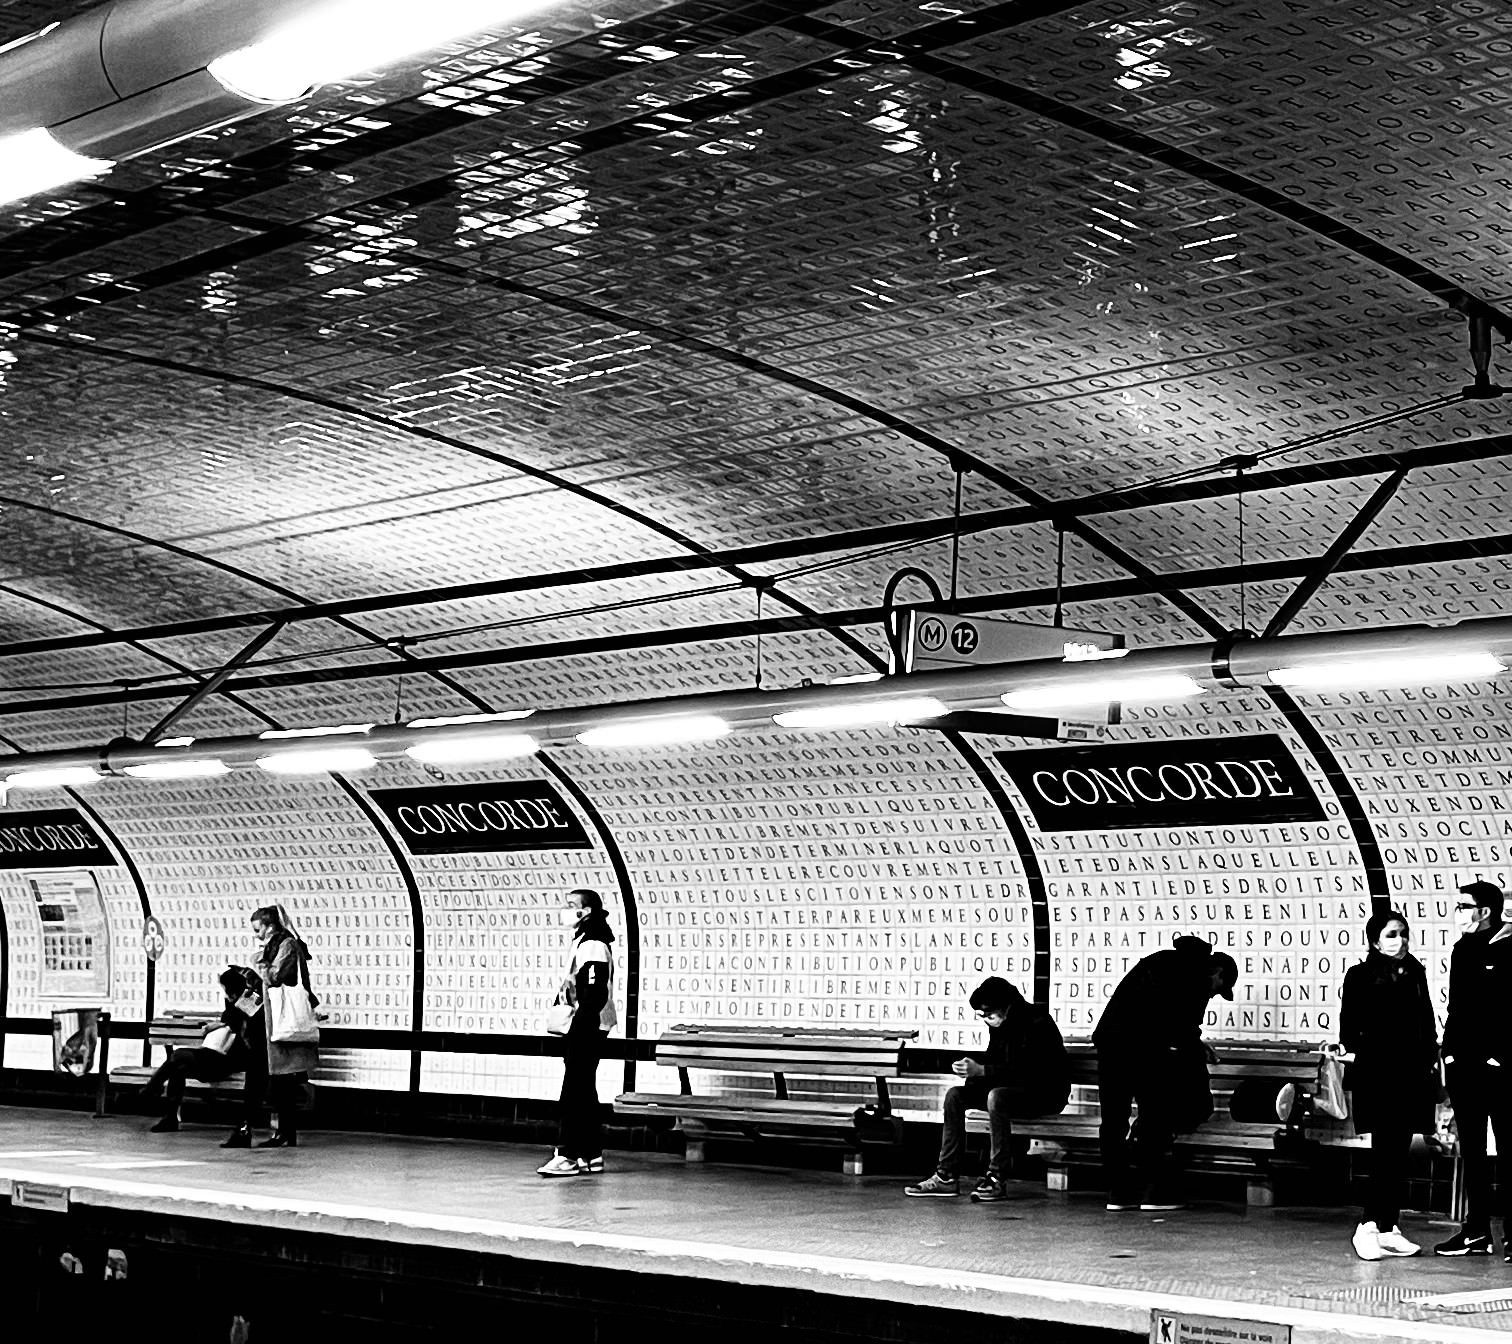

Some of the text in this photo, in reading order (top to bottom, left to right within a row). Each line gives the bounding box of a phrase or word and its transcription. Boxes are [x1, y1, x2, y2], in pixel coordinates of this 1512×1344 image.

[925, 626, 974, 650] M 12
[1033, 759, 1293, 806] CONCORDE
[398, 798, 568, 834] CONCORDE
[0, 823, 98, 852] ONCORDE
